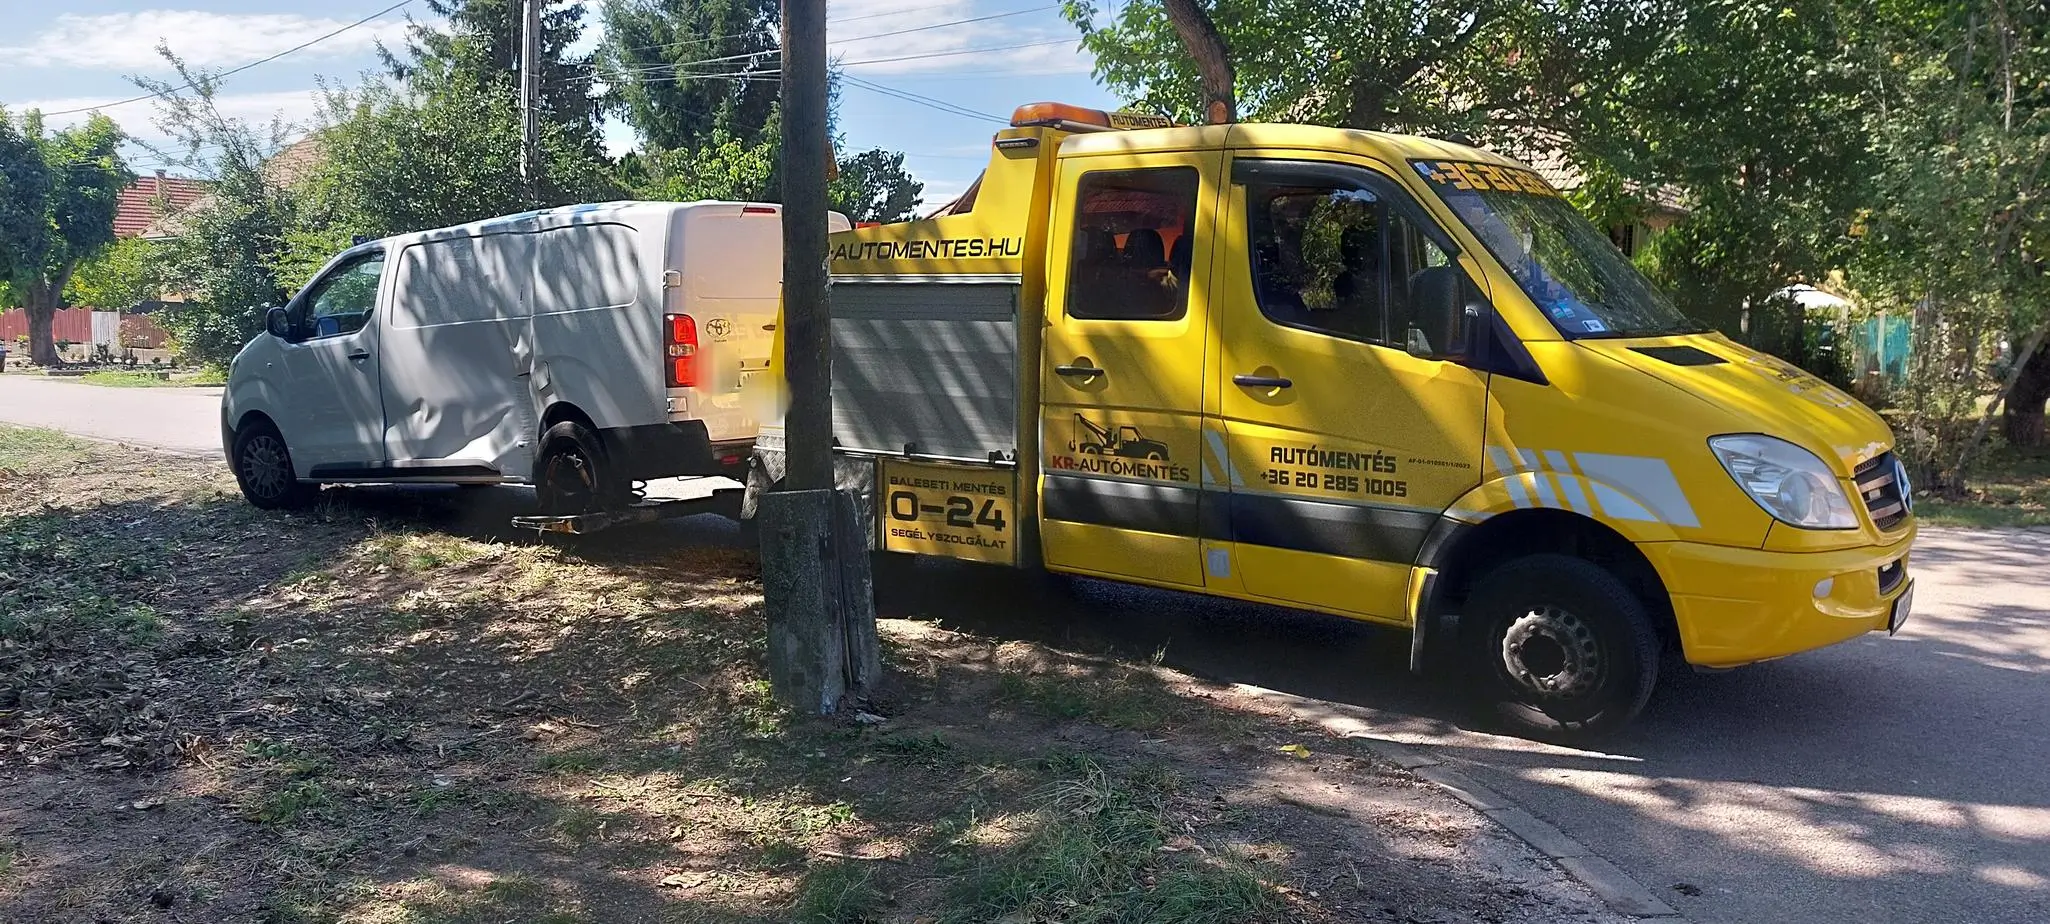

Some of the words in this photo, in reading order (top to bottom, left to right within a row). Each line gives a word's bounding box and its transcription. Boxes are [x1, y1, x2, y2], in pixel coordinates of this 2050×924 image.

[1052, 455, 1190, 481] KR-AUTÓMENTÉS
[1270, 445, 1396, 473] AUTÓMENTÉS
[953, 482, 1006, 495] MENTÉS
[1260, 469, 1289, 486] +36
[1295, 471, 1318, 488] 20
[1323, 474, 1359, 492] 285
[1364, 478, 1407, 498] 1005
[891, 528, 1006, 549] SEGÉLYSZOLGÁLAT
